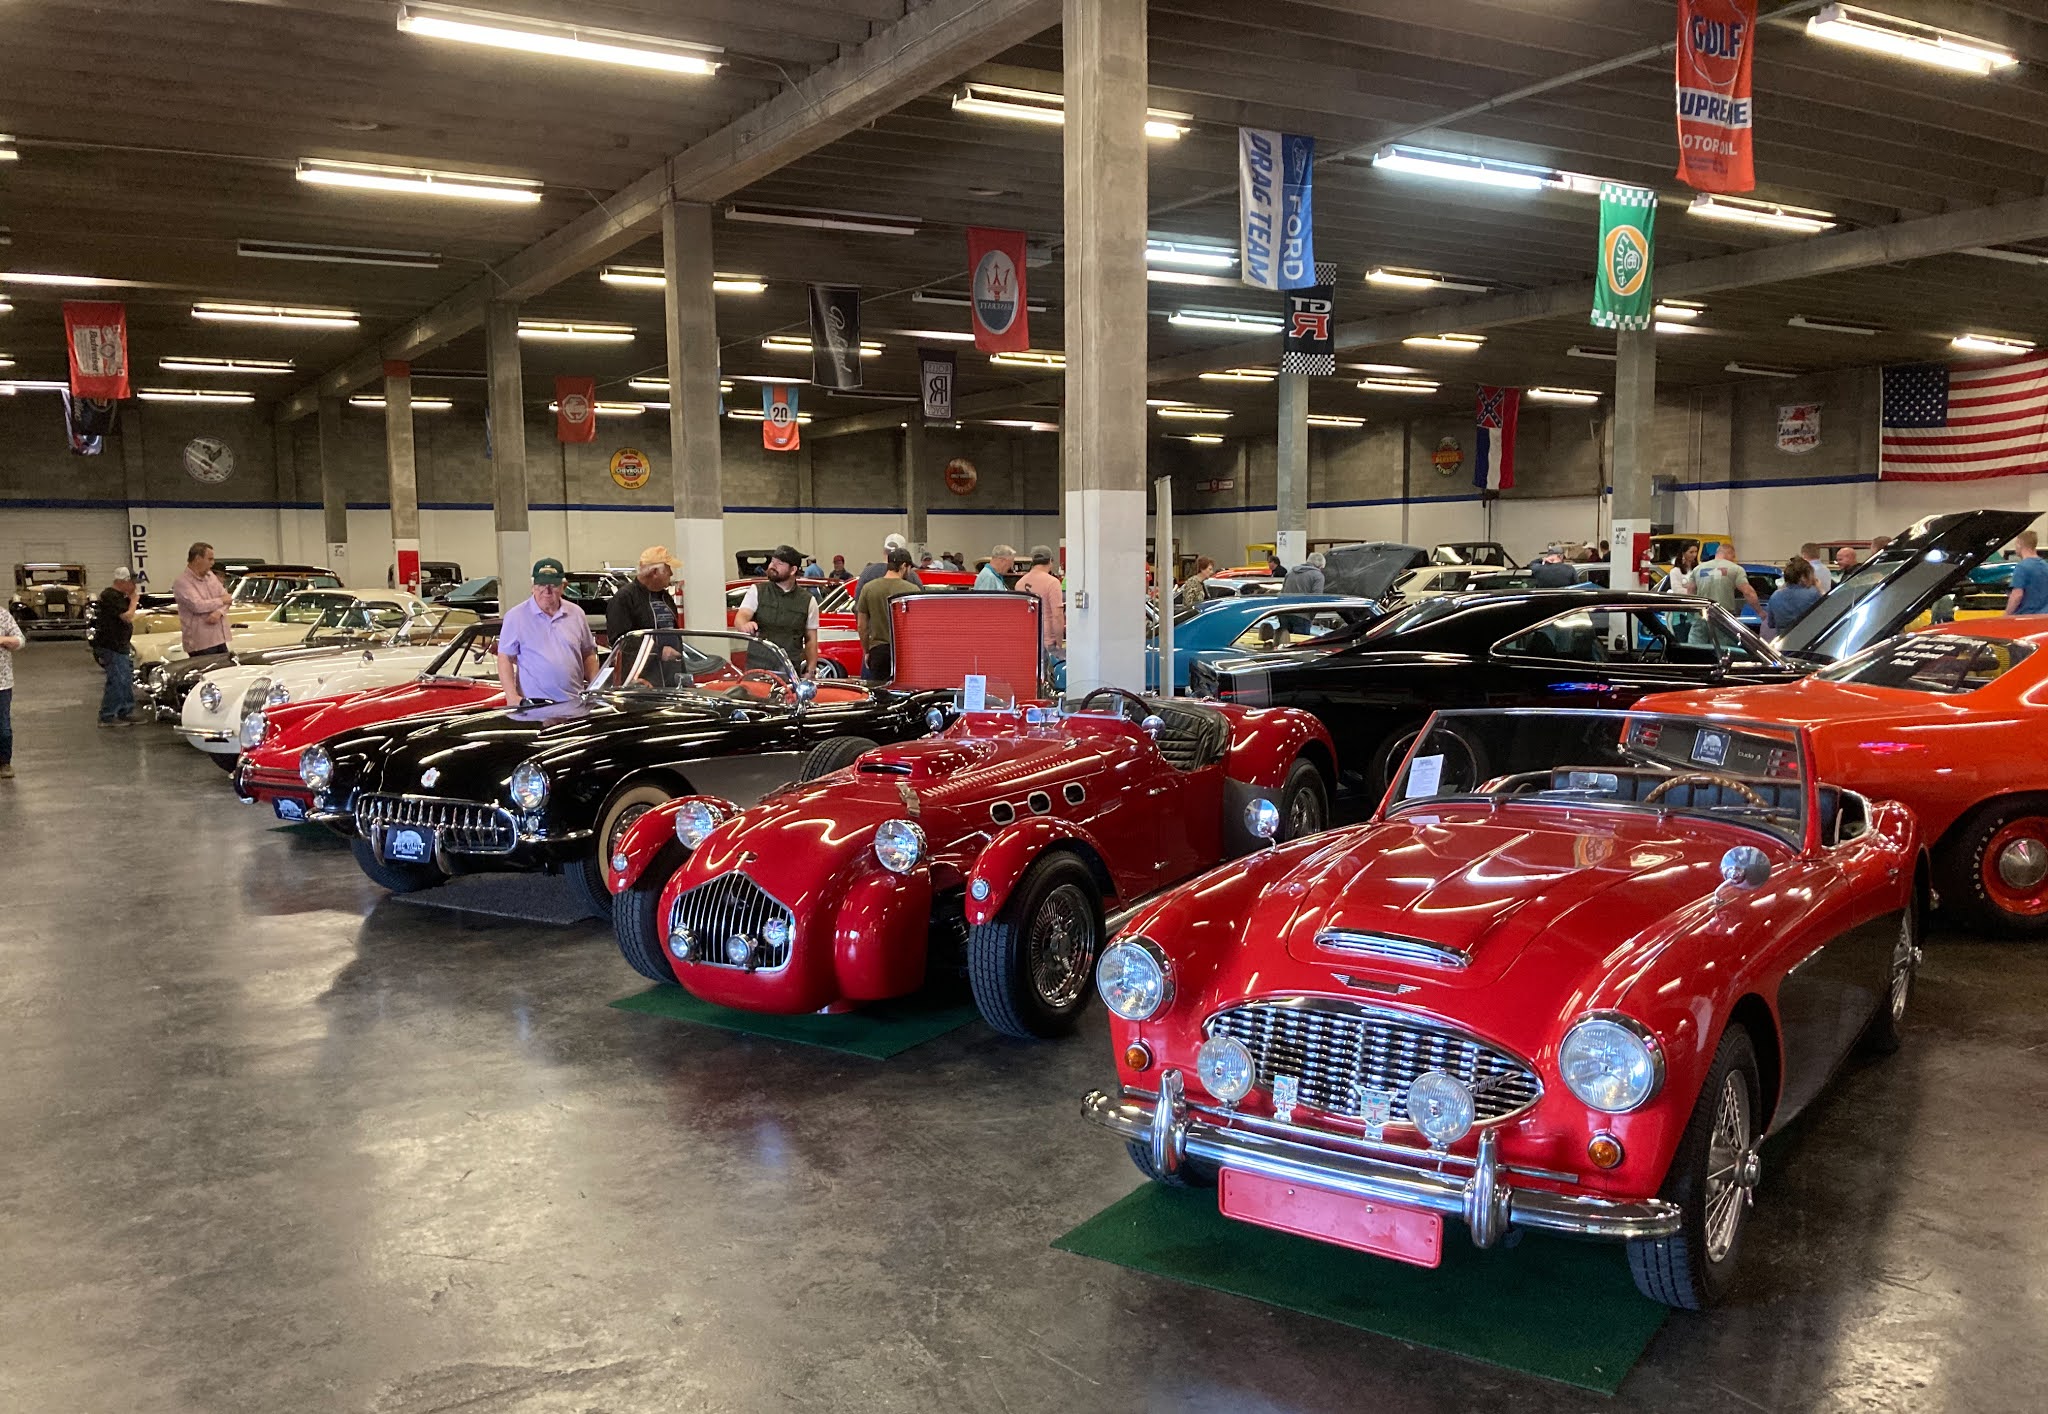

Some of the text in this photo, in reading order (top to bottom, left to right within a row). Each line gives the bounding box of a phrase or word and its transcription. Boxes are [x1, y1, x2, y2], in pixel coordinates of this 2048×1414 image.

[1692, 15, 1743, 60] GULF
[1682, 134, 1719, 153] OTOR
[1247, 132, 1273, 285] DRAG TEAM
[1283, 194, 1304, 281] FORD
[1616, 234, 1629, 286] LOTUS
[89, 330, 100, 373] Budweiser
[773, 407, 788, 422] 20
[132, 524, 150, 593] DETAI
